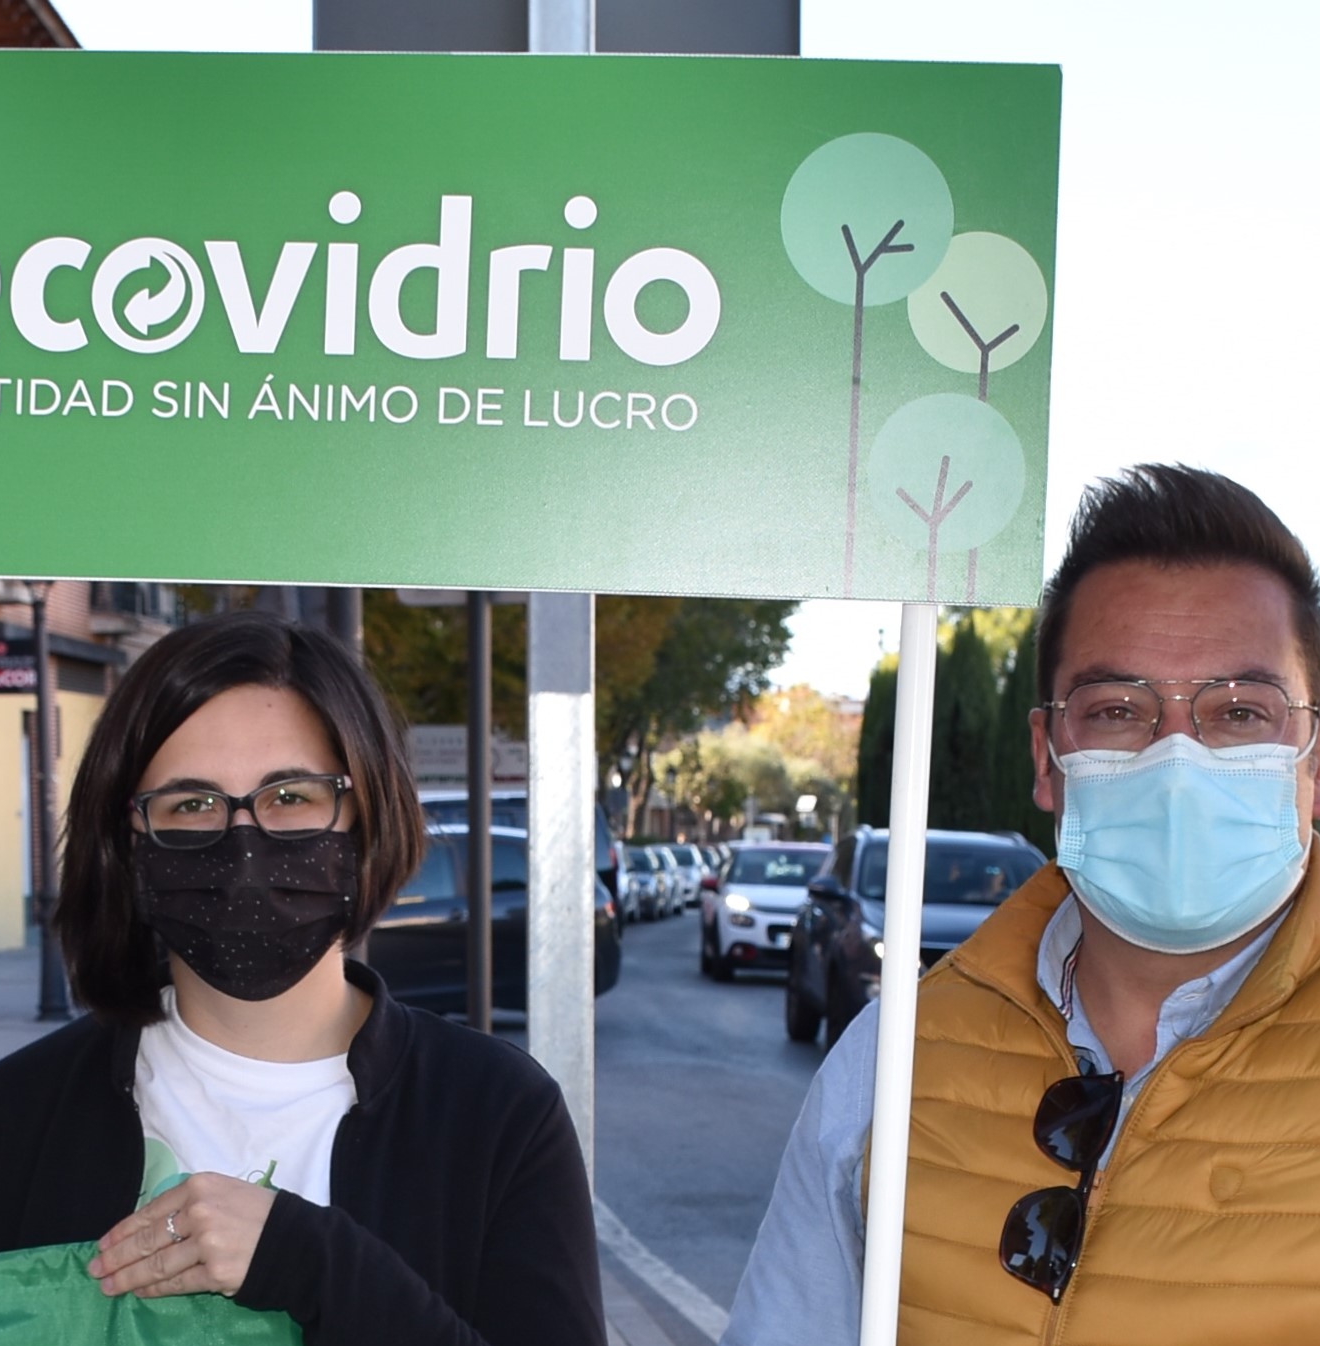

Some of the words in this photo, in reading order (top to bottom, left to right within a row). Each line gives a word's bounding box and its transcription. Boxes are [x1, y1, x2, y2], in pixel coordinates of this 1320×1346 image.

[151, 380, 230, 420] SIN
[247, 373, 419, 425] ÁNIMO
[438, 386, 504, 427] DE
[524, 390, 699, 432] LUCRO
